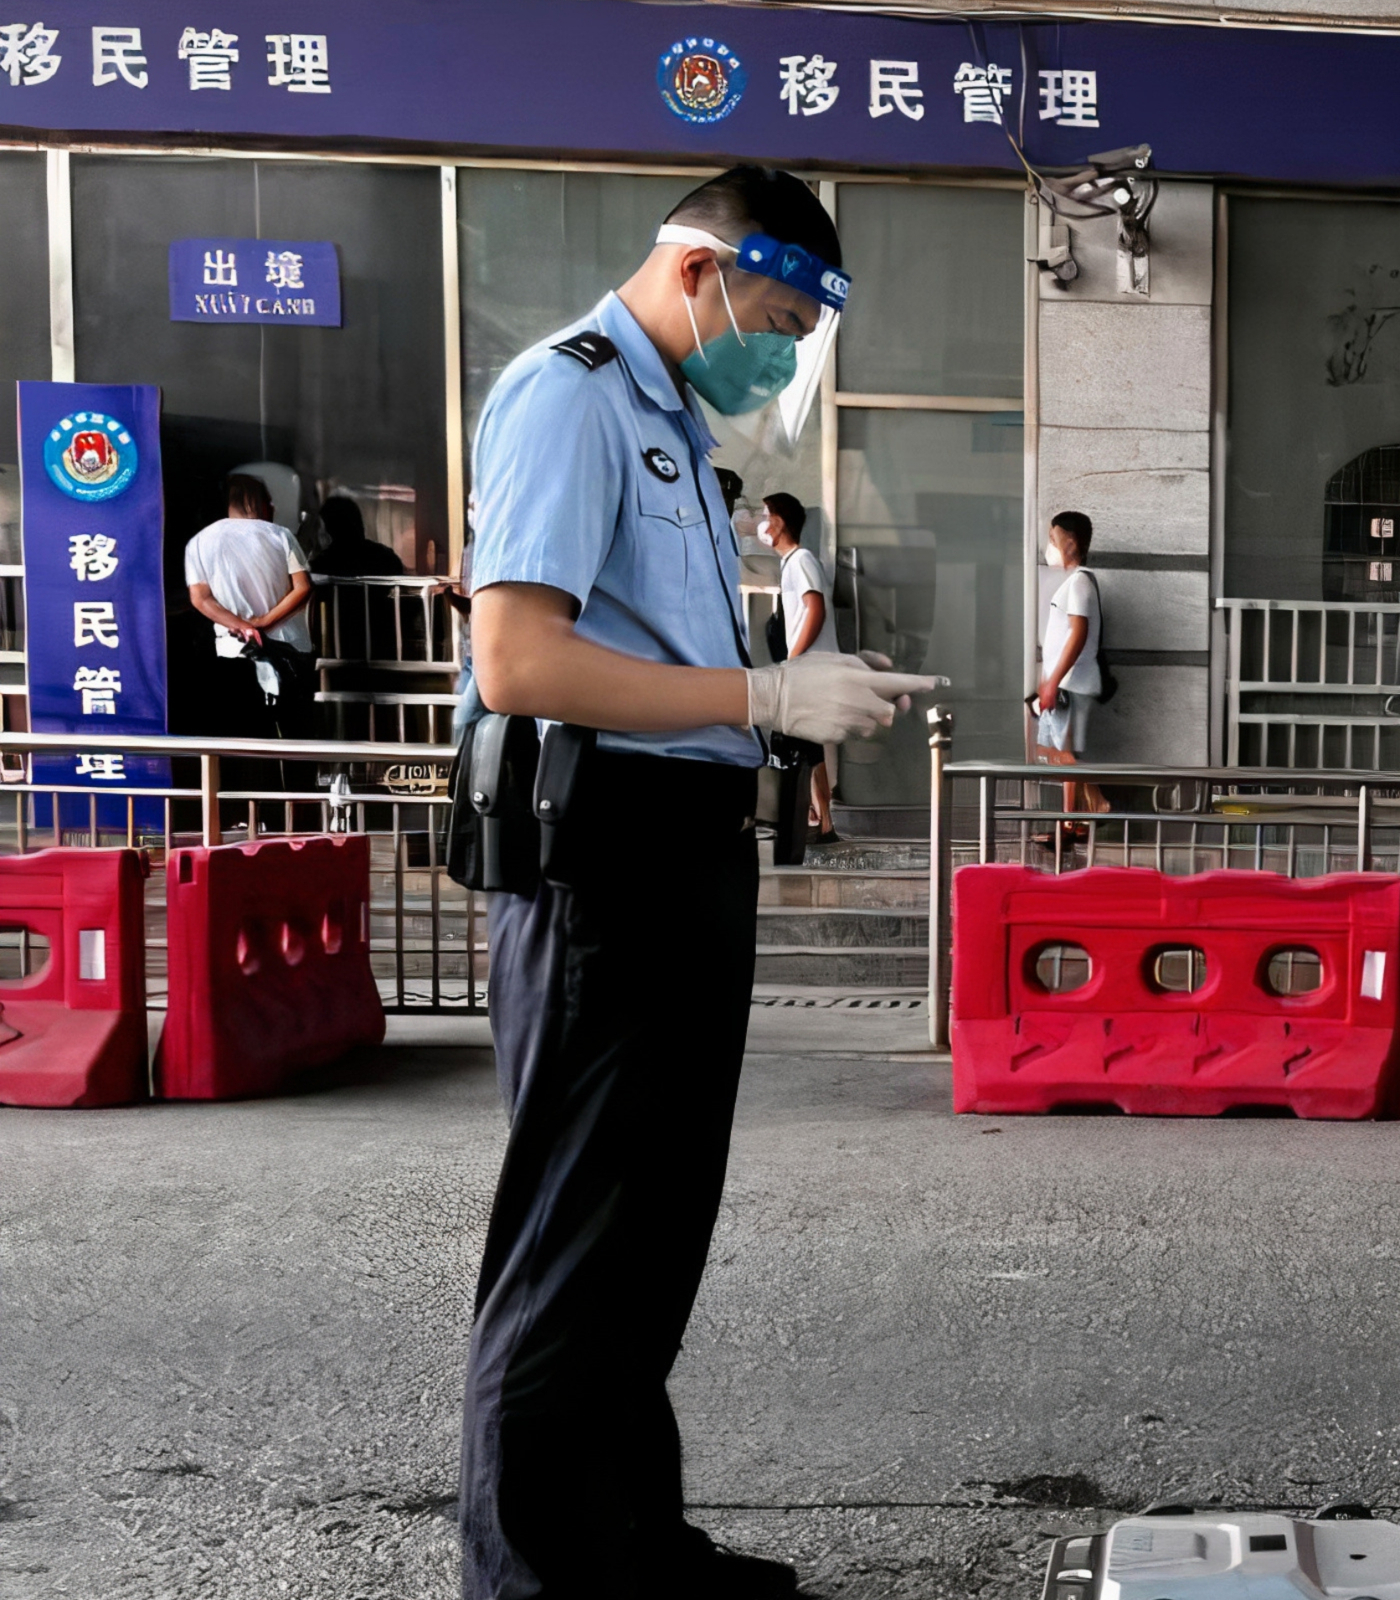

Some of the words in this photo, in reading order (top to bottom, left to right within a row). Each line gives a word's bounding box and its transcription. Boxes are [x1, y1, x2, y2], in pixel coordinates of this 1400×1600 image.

[0, 22, 331, 93] 移民管理
[779, 54, 1100, 128] 移民管理
